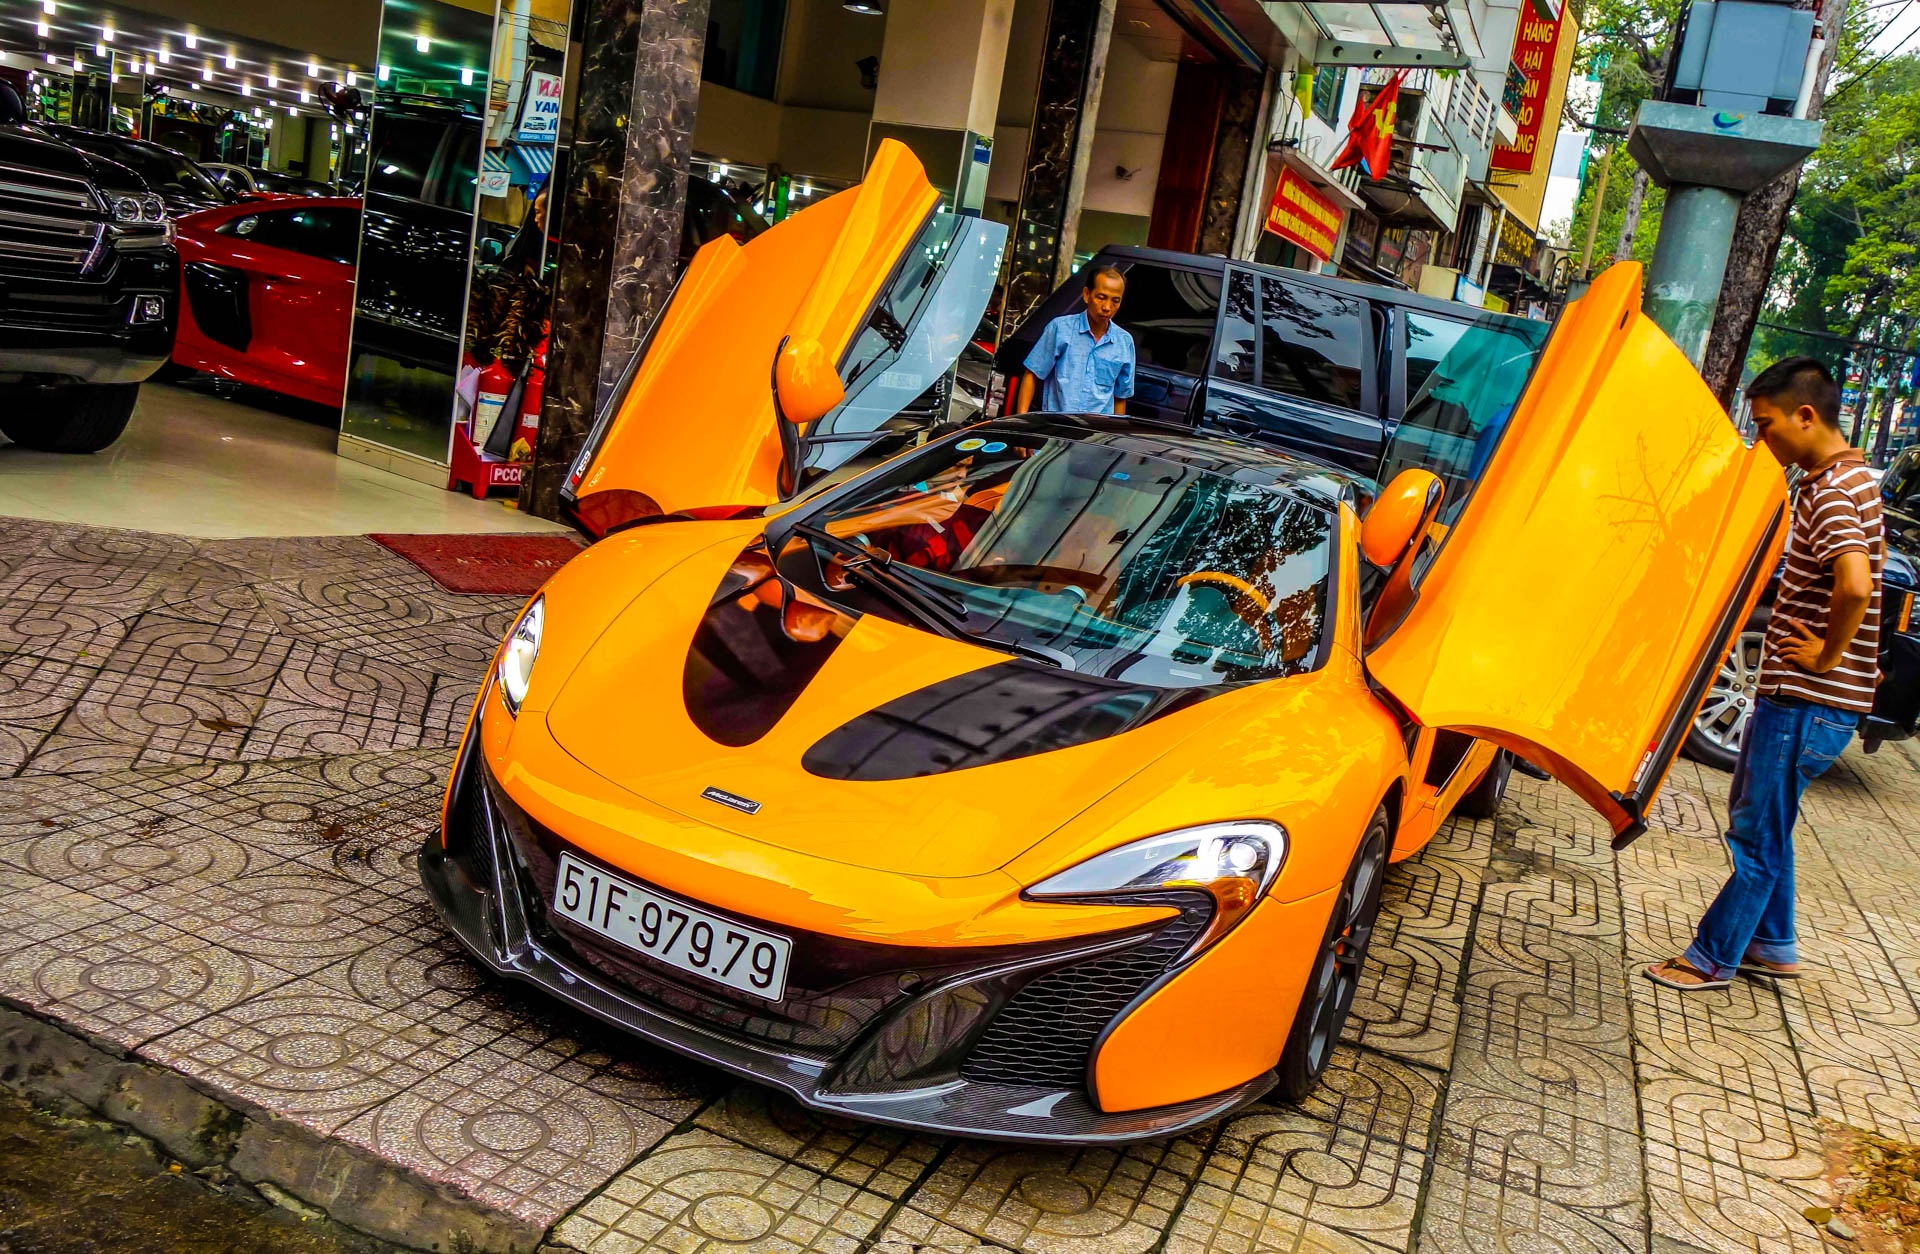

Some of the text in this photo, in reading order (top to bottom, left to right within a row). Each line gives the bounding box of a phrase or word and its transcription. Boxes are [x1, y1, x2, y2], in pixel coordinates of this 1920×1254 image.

[1522, 18, 1554, 43] HÀNG
[707, 791, 750, 808] McLaren
[562, 863, 777, 988] 51F-979.79
